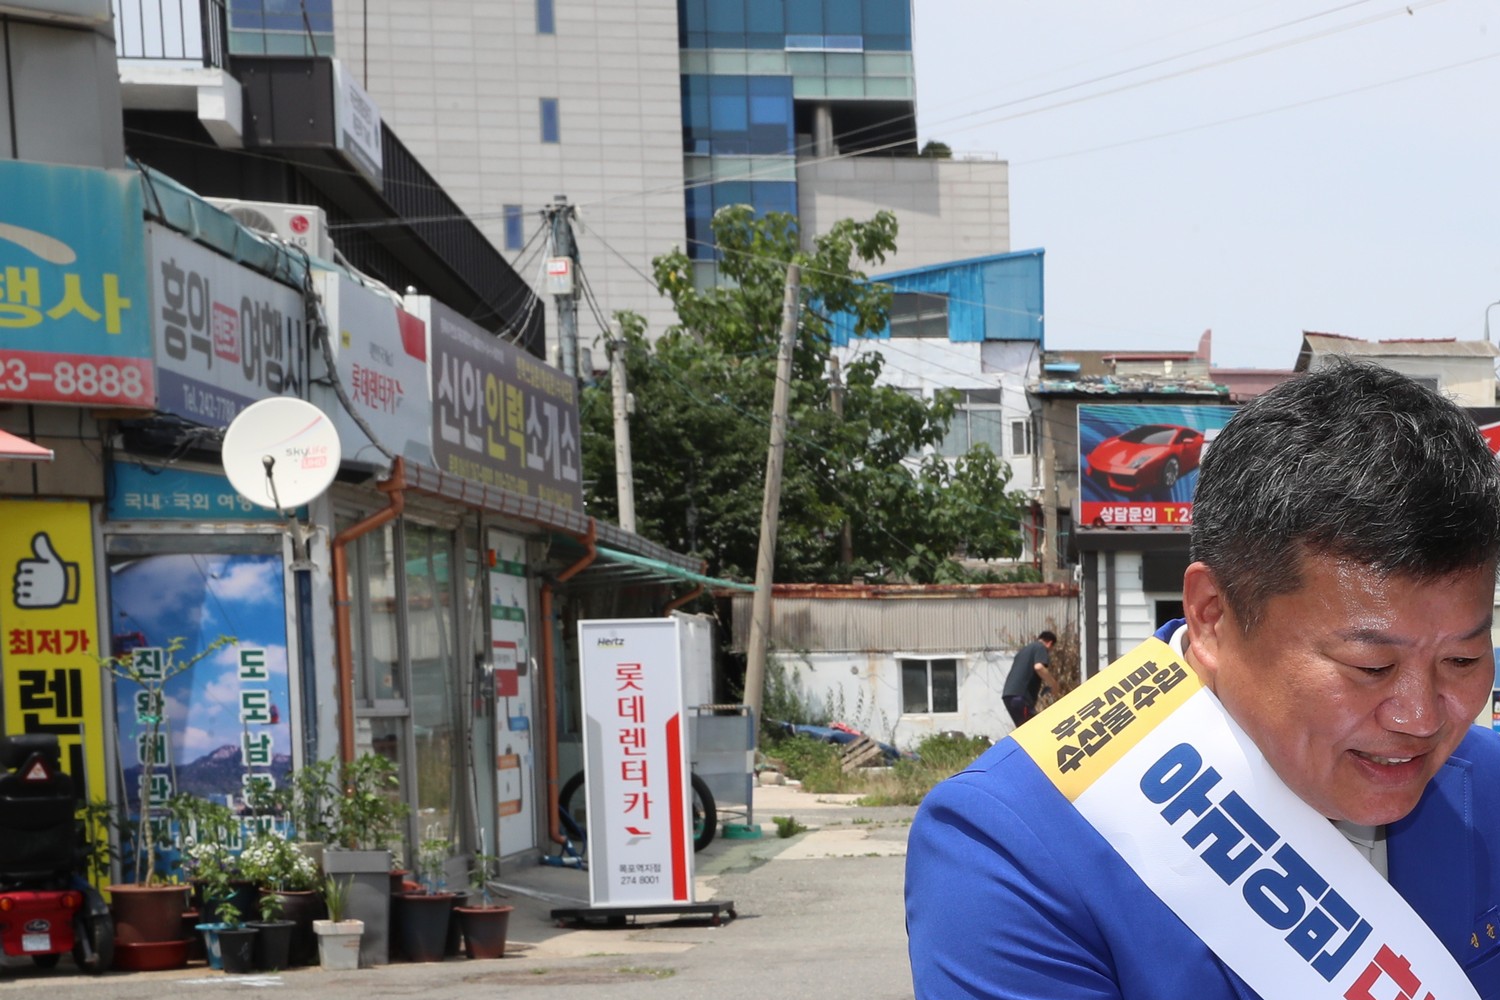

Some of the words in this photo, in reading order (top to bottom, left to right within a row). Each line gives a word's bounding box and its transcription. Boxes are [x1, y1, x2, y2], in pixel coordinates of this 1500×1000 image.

[161, 257, 213, 371] 홍익
[240, 296, 304, 398] 여행사
[0, 359, 143, 398] 3-8888
[438, 351, 577, 483] 신안인력소개소
[1100, 507, 1156, 522] 상담문의
[9, 629, 90, 655] 최저가
[597, 637, 625, 646] Hertz
[1051, 660, 1159, 742] 후쿠시마
[1056, 700, 1137, 775] 수산물
[1132, 661, 1188, 712] 수입
[615, 663, 653, 820] 롯데렌터카
[620, 876, 637, 885] 274
